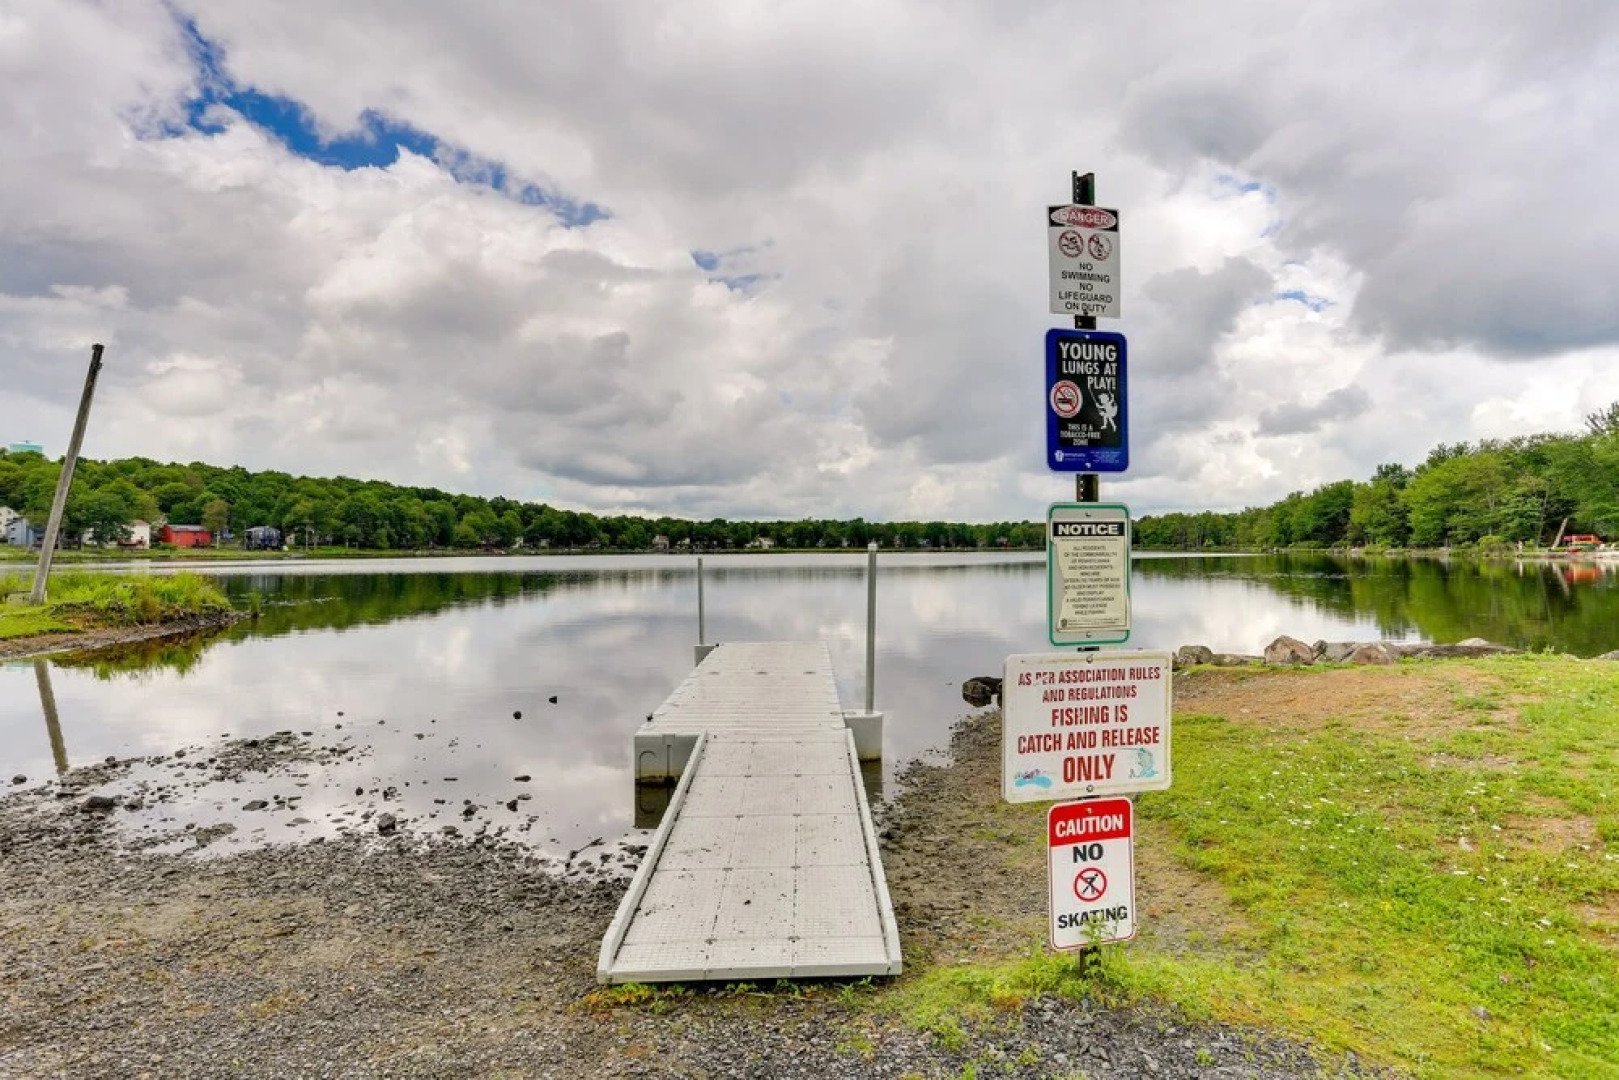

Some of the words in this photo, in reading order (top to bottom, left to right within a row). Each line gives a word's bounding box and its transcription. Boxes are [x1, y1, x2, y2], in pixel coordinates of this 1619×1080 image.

[1060, 211, 1108, 224] DANGER
[1079, 262, 1093, 271] NO
[1061, 271, 1110, 283] SWIMMING
[1079, 283, 1093, 291] NO
[1059, 291, 1112, 303] LIFEGUARD
[1065, 301, 1079, 310] ON
[1081, 303, 1107, 313] DUTY
[1059, 342, 1117, 361] YOUNG
[1062, 361, 1100, 374] LUNGS
[1104, 363, 1117, 376] AT
[1088, 376, 1116, 389] PLAY!
[1060, 430, 1101, 439] TOBACCO-FREE
[1058, 524, 1118, 535] NOTICE
[1018, 672, 1032, 685] AS
[1058, 668, 1126, 684] ASSOCIATION
[1129, 666, 1160, 680] RULES
[1042, 689, 1064, 703] AND
[1068, 685, 1137, 701] REGULATIONS
[1051, 705, 1109, 727] FISHING
[1115, 704, 1128, 722] IS
[1018, 732, 1062, 754] CATCH
[1067, 731, 1096, 750] AND
[1102, 727, 1160, 747] RELEASE
[1063, 754, 1115, 783] ONLY
[1055, 814, 1123, 838] CAUTION
[1072, 843, 1104, 863] NO
